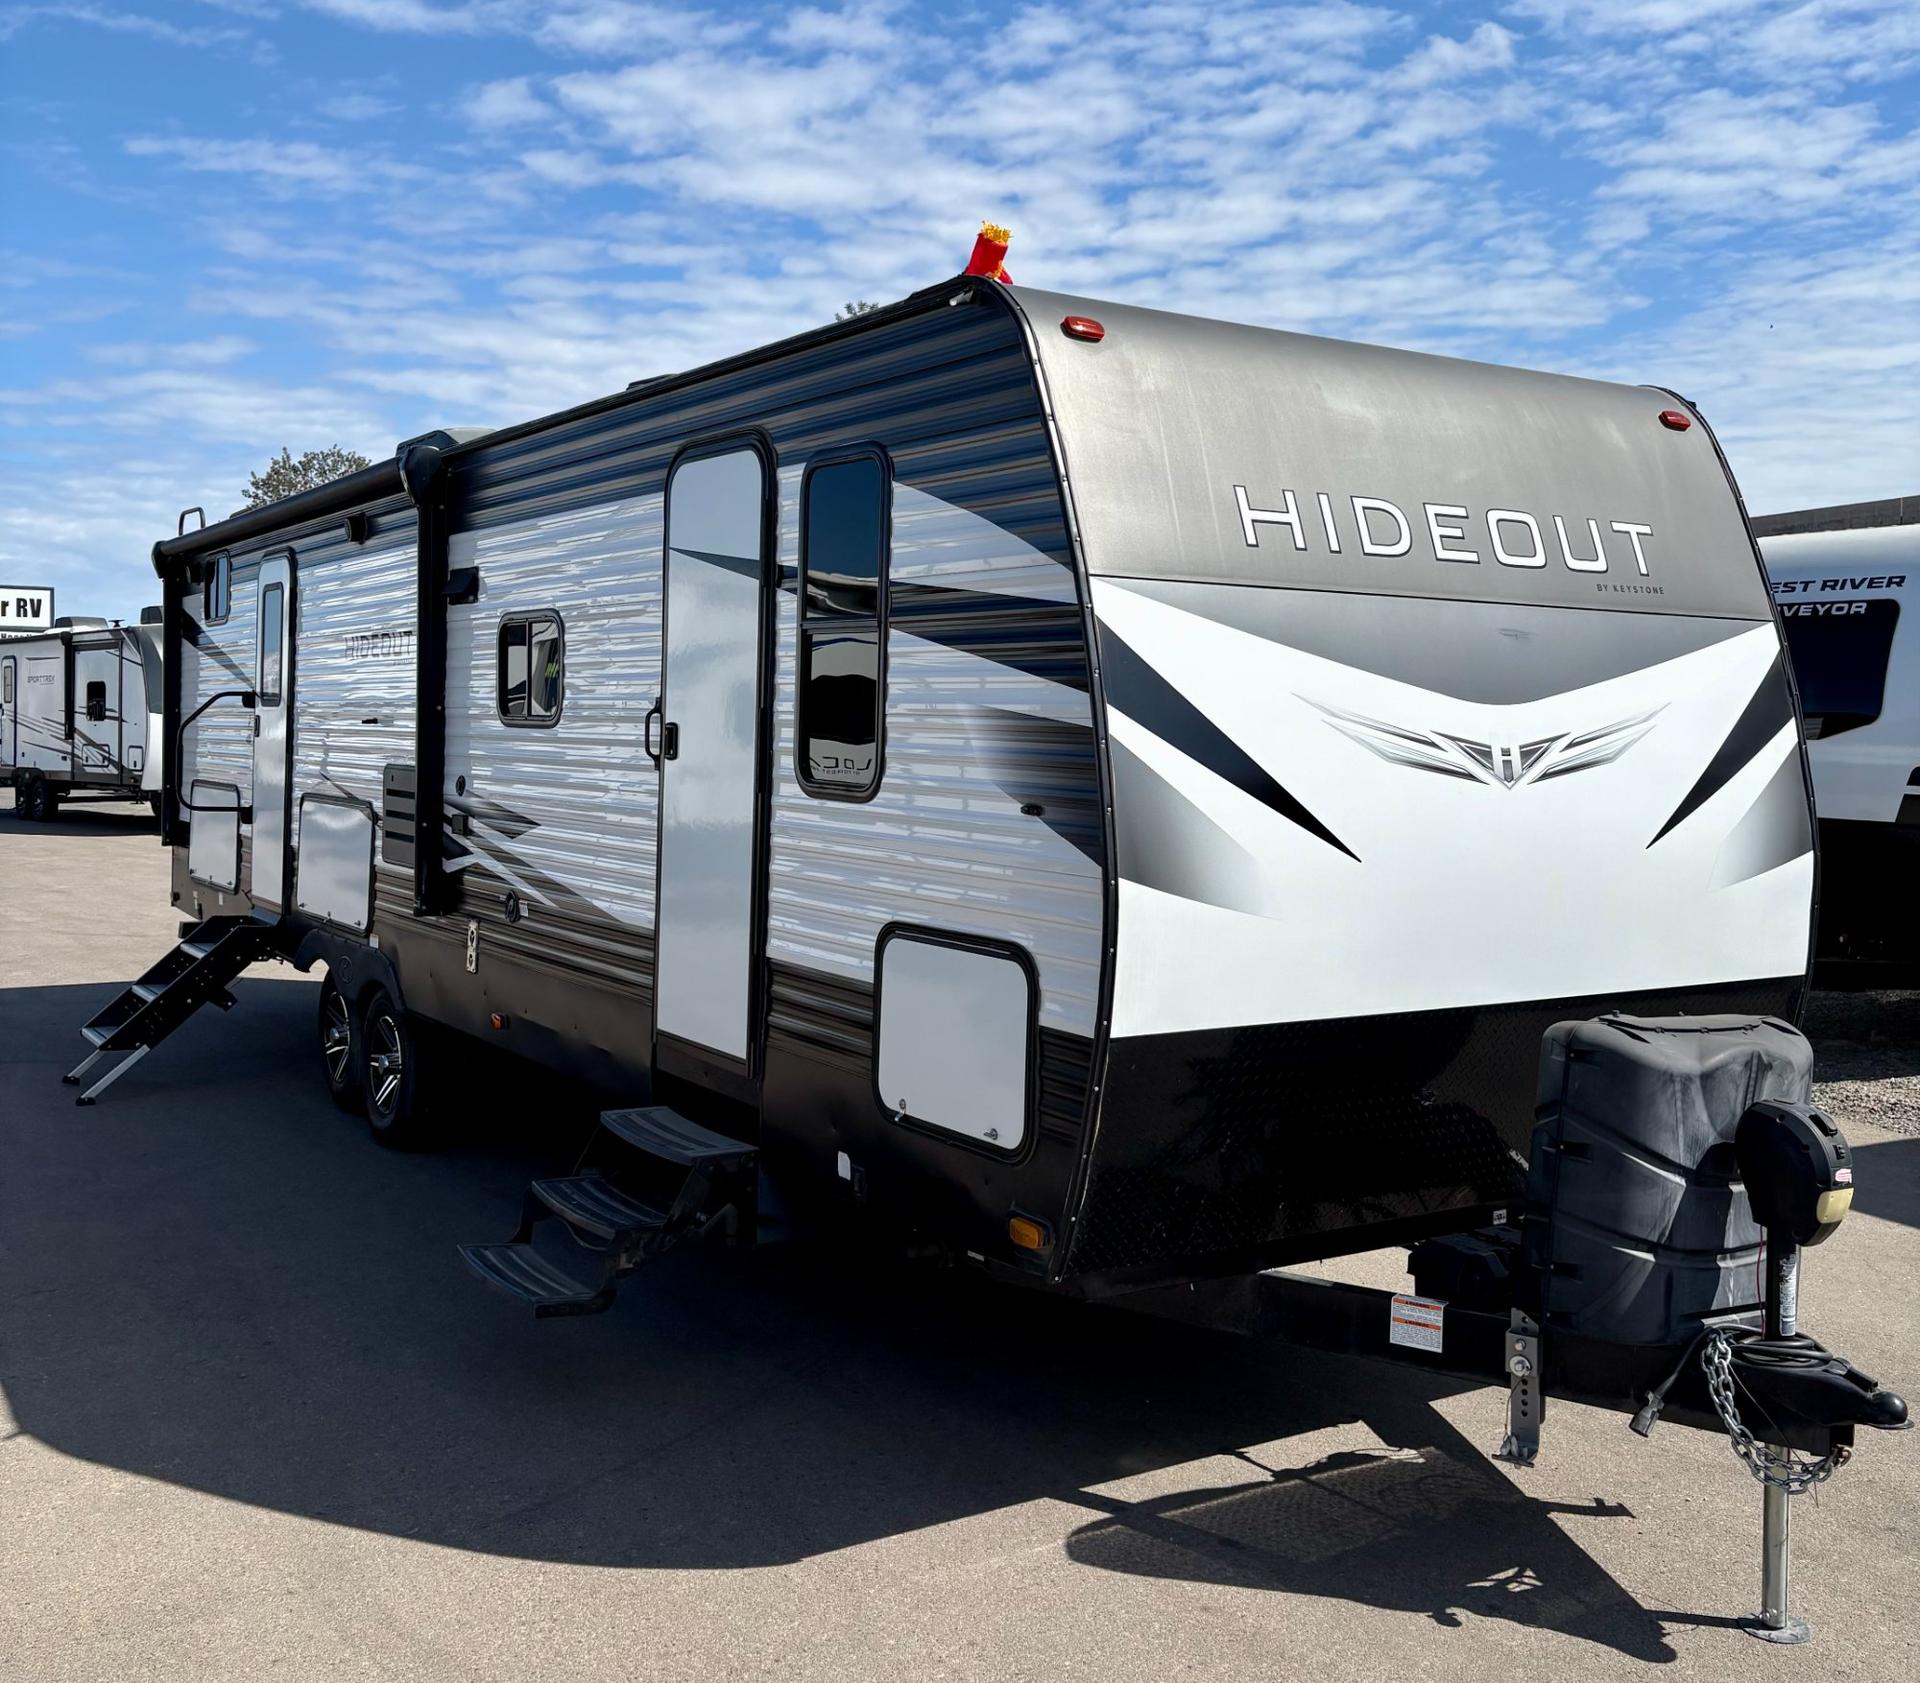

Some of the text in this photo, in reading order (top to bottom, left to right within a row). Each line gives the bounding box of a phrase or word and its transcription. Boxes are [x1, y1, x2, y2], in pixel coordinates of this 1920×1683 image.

[1232, 484, 1654, 577] HIDEOUT
[1596, 583, 1665, 595] BY KEYSTONE
[1820, 575, 1907, 592] RIVER
[16, 597, 42, 618] RV
[1777, 602, 1868, 617] VEYOR
[344, 630, 413, 660] HIDEOUT
